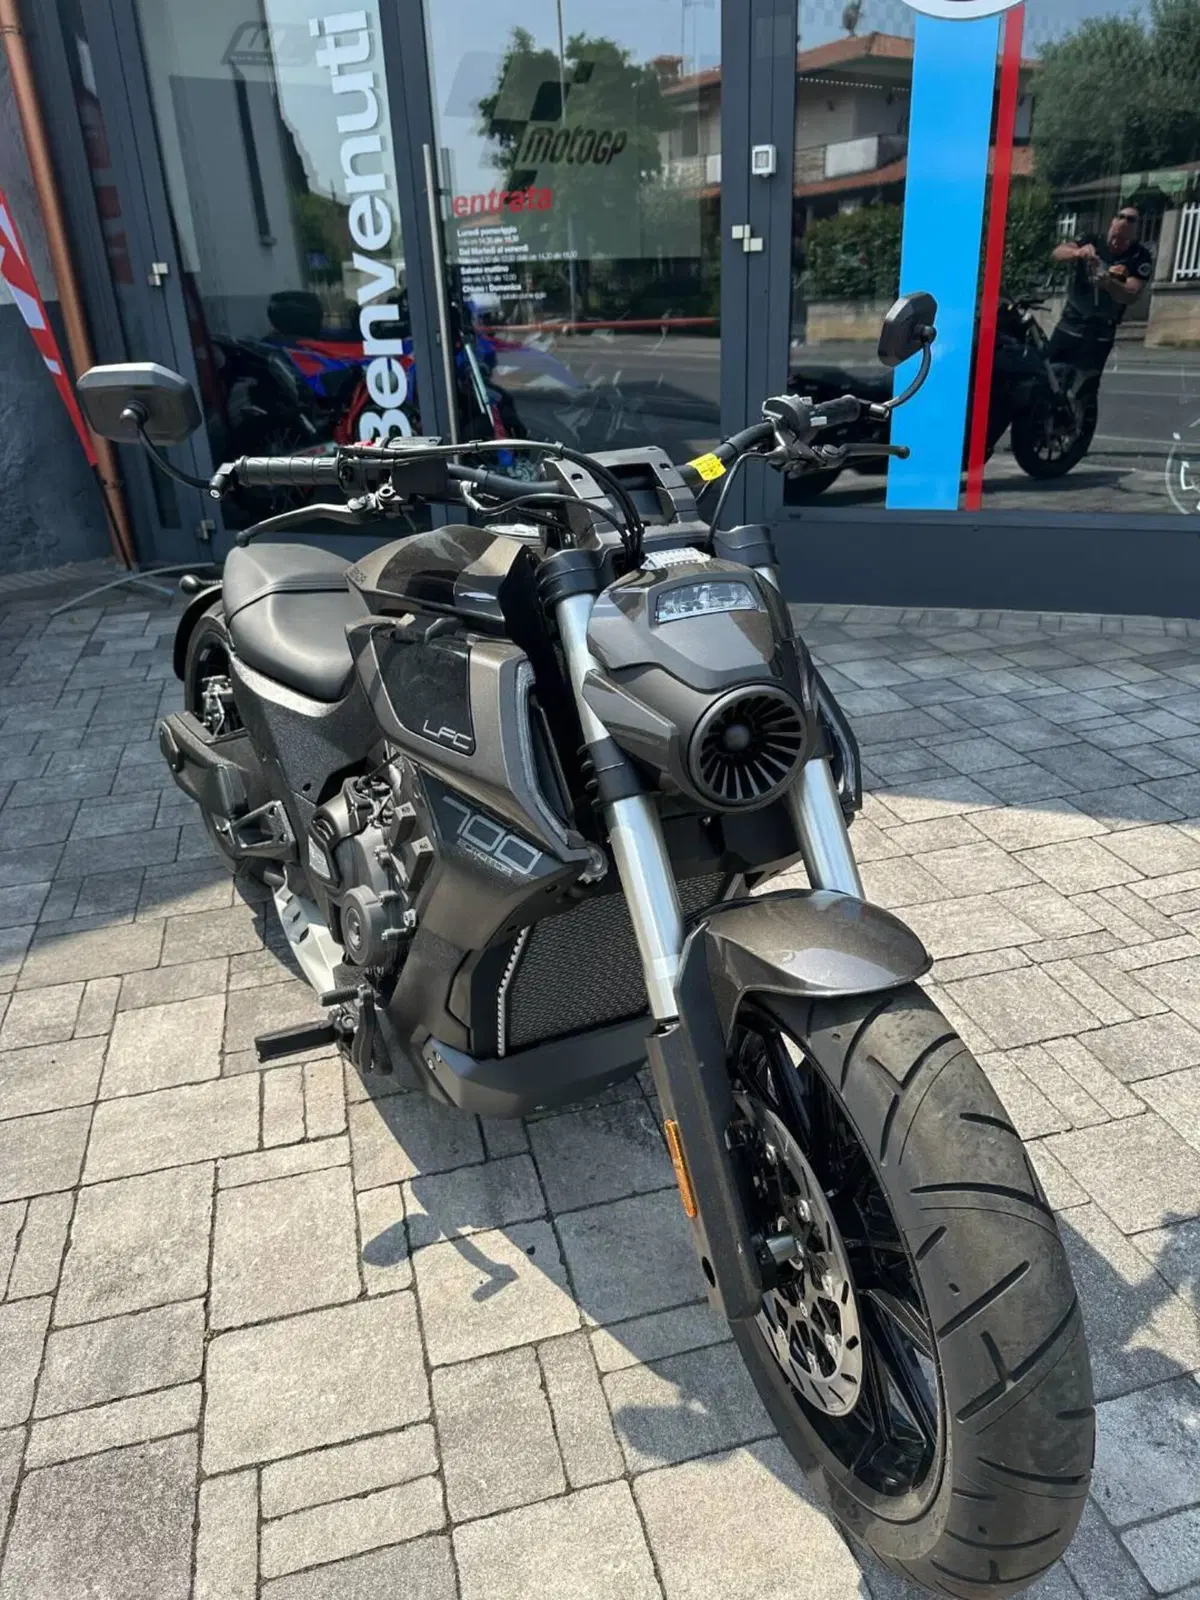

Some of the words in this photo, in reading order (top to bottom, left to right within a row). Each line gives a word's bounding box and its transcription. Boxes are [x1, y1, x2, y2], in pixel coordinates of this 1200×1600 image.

[452, 184, 553, 217] entrata
[423, 719, 472, 750] LFC
[443, 796, 543, 875] 700
